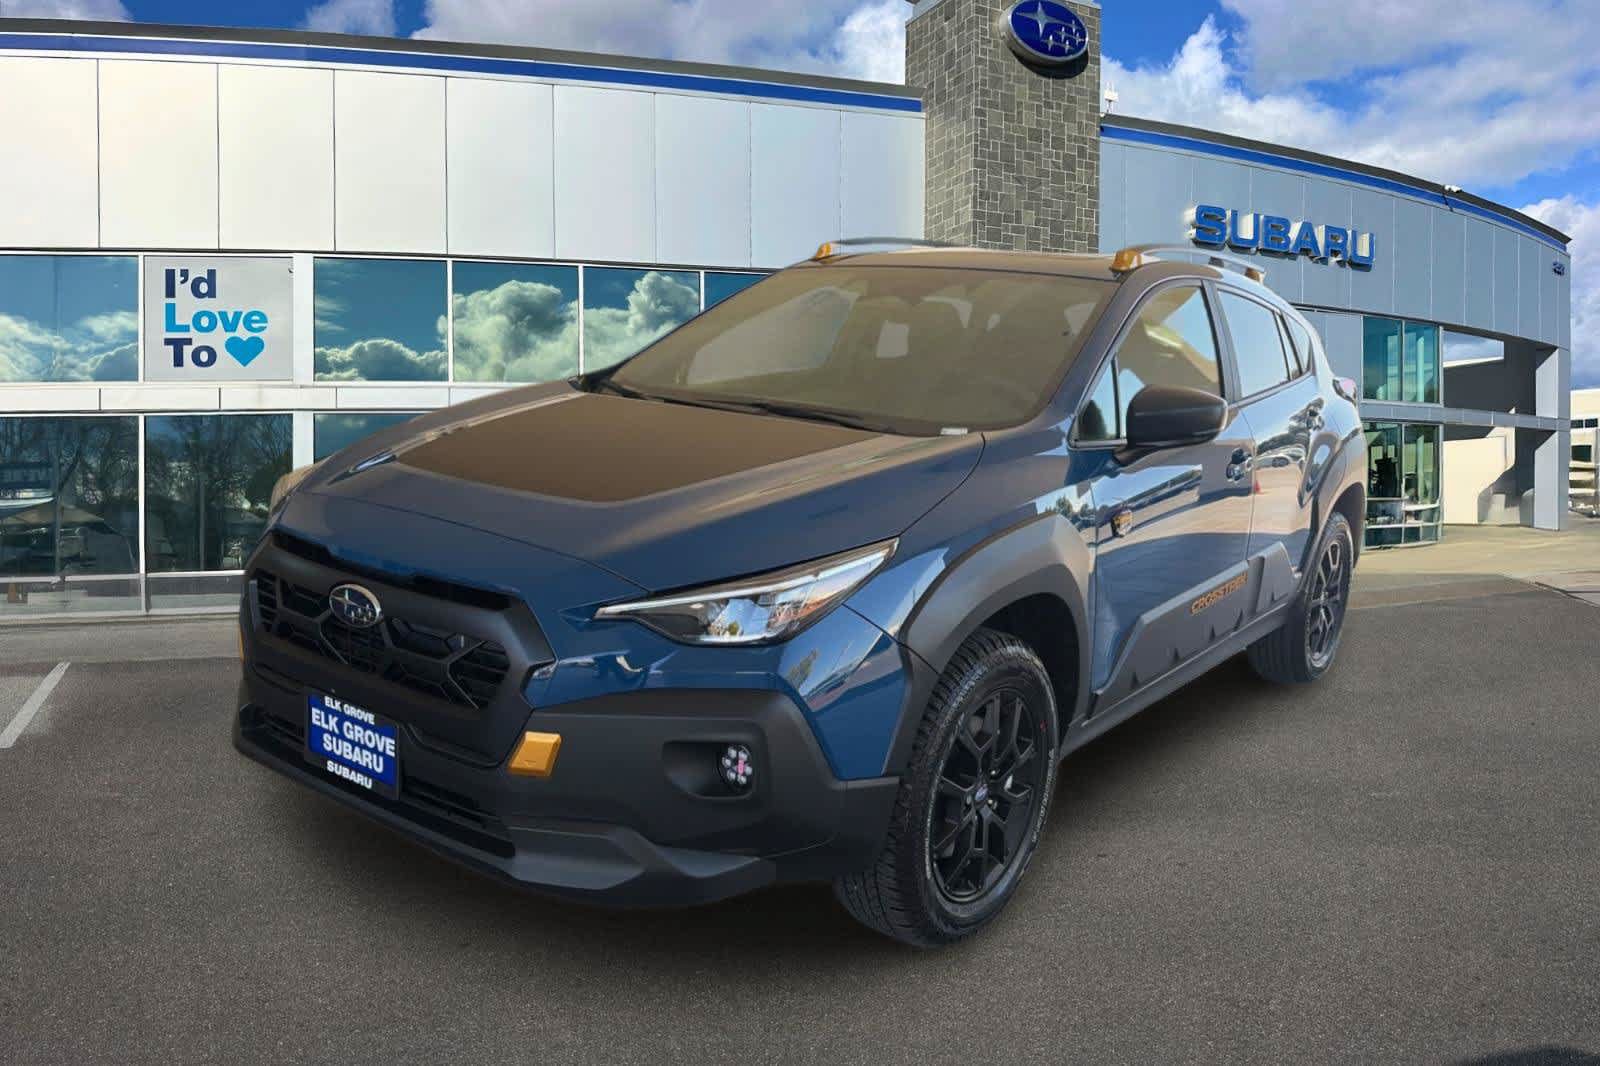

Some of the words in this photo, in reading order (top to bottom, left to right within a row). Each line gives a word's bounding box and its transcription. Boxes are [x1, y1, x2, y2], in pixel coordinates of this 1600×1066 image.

[1192, 204, 1376, 272] SUBARU
[165, 268, 217, 299] I'd
[165, 302, 269, 333] Love
[164, 338, 217, 368] To
[324, 695, 342, 712] ELK
[343, 703, 375, 725] GROVE
[311, 707, 340, 735] ELK
[343, 721, 395, 758] GROVE
[322, 733, 384, 773] SUBARU
[326, 760, 373, 789] SUBARU
